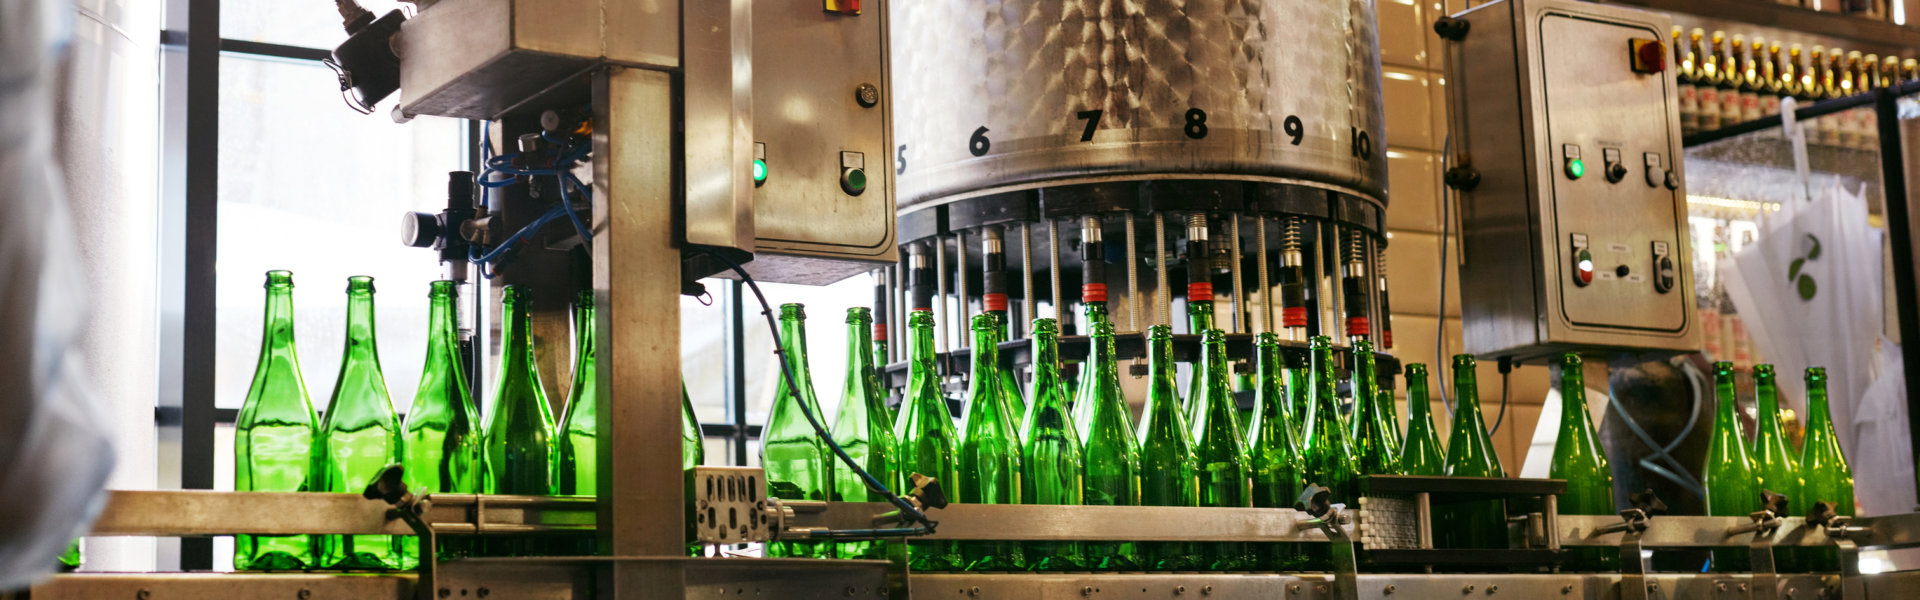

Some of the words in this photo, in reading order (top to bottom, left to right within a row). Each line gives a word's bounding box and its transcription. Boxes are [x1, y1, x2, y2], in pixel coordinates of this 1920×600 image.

[1077, 109, 1104, 143] 7
[1184, 107, 1208, 140] 8
[1283, 115, 1304, 146] 9
[969, 126, 991, 157] 6
[1351, 126, 1372, 160] 10
[896, 144, 907, 175] 5
